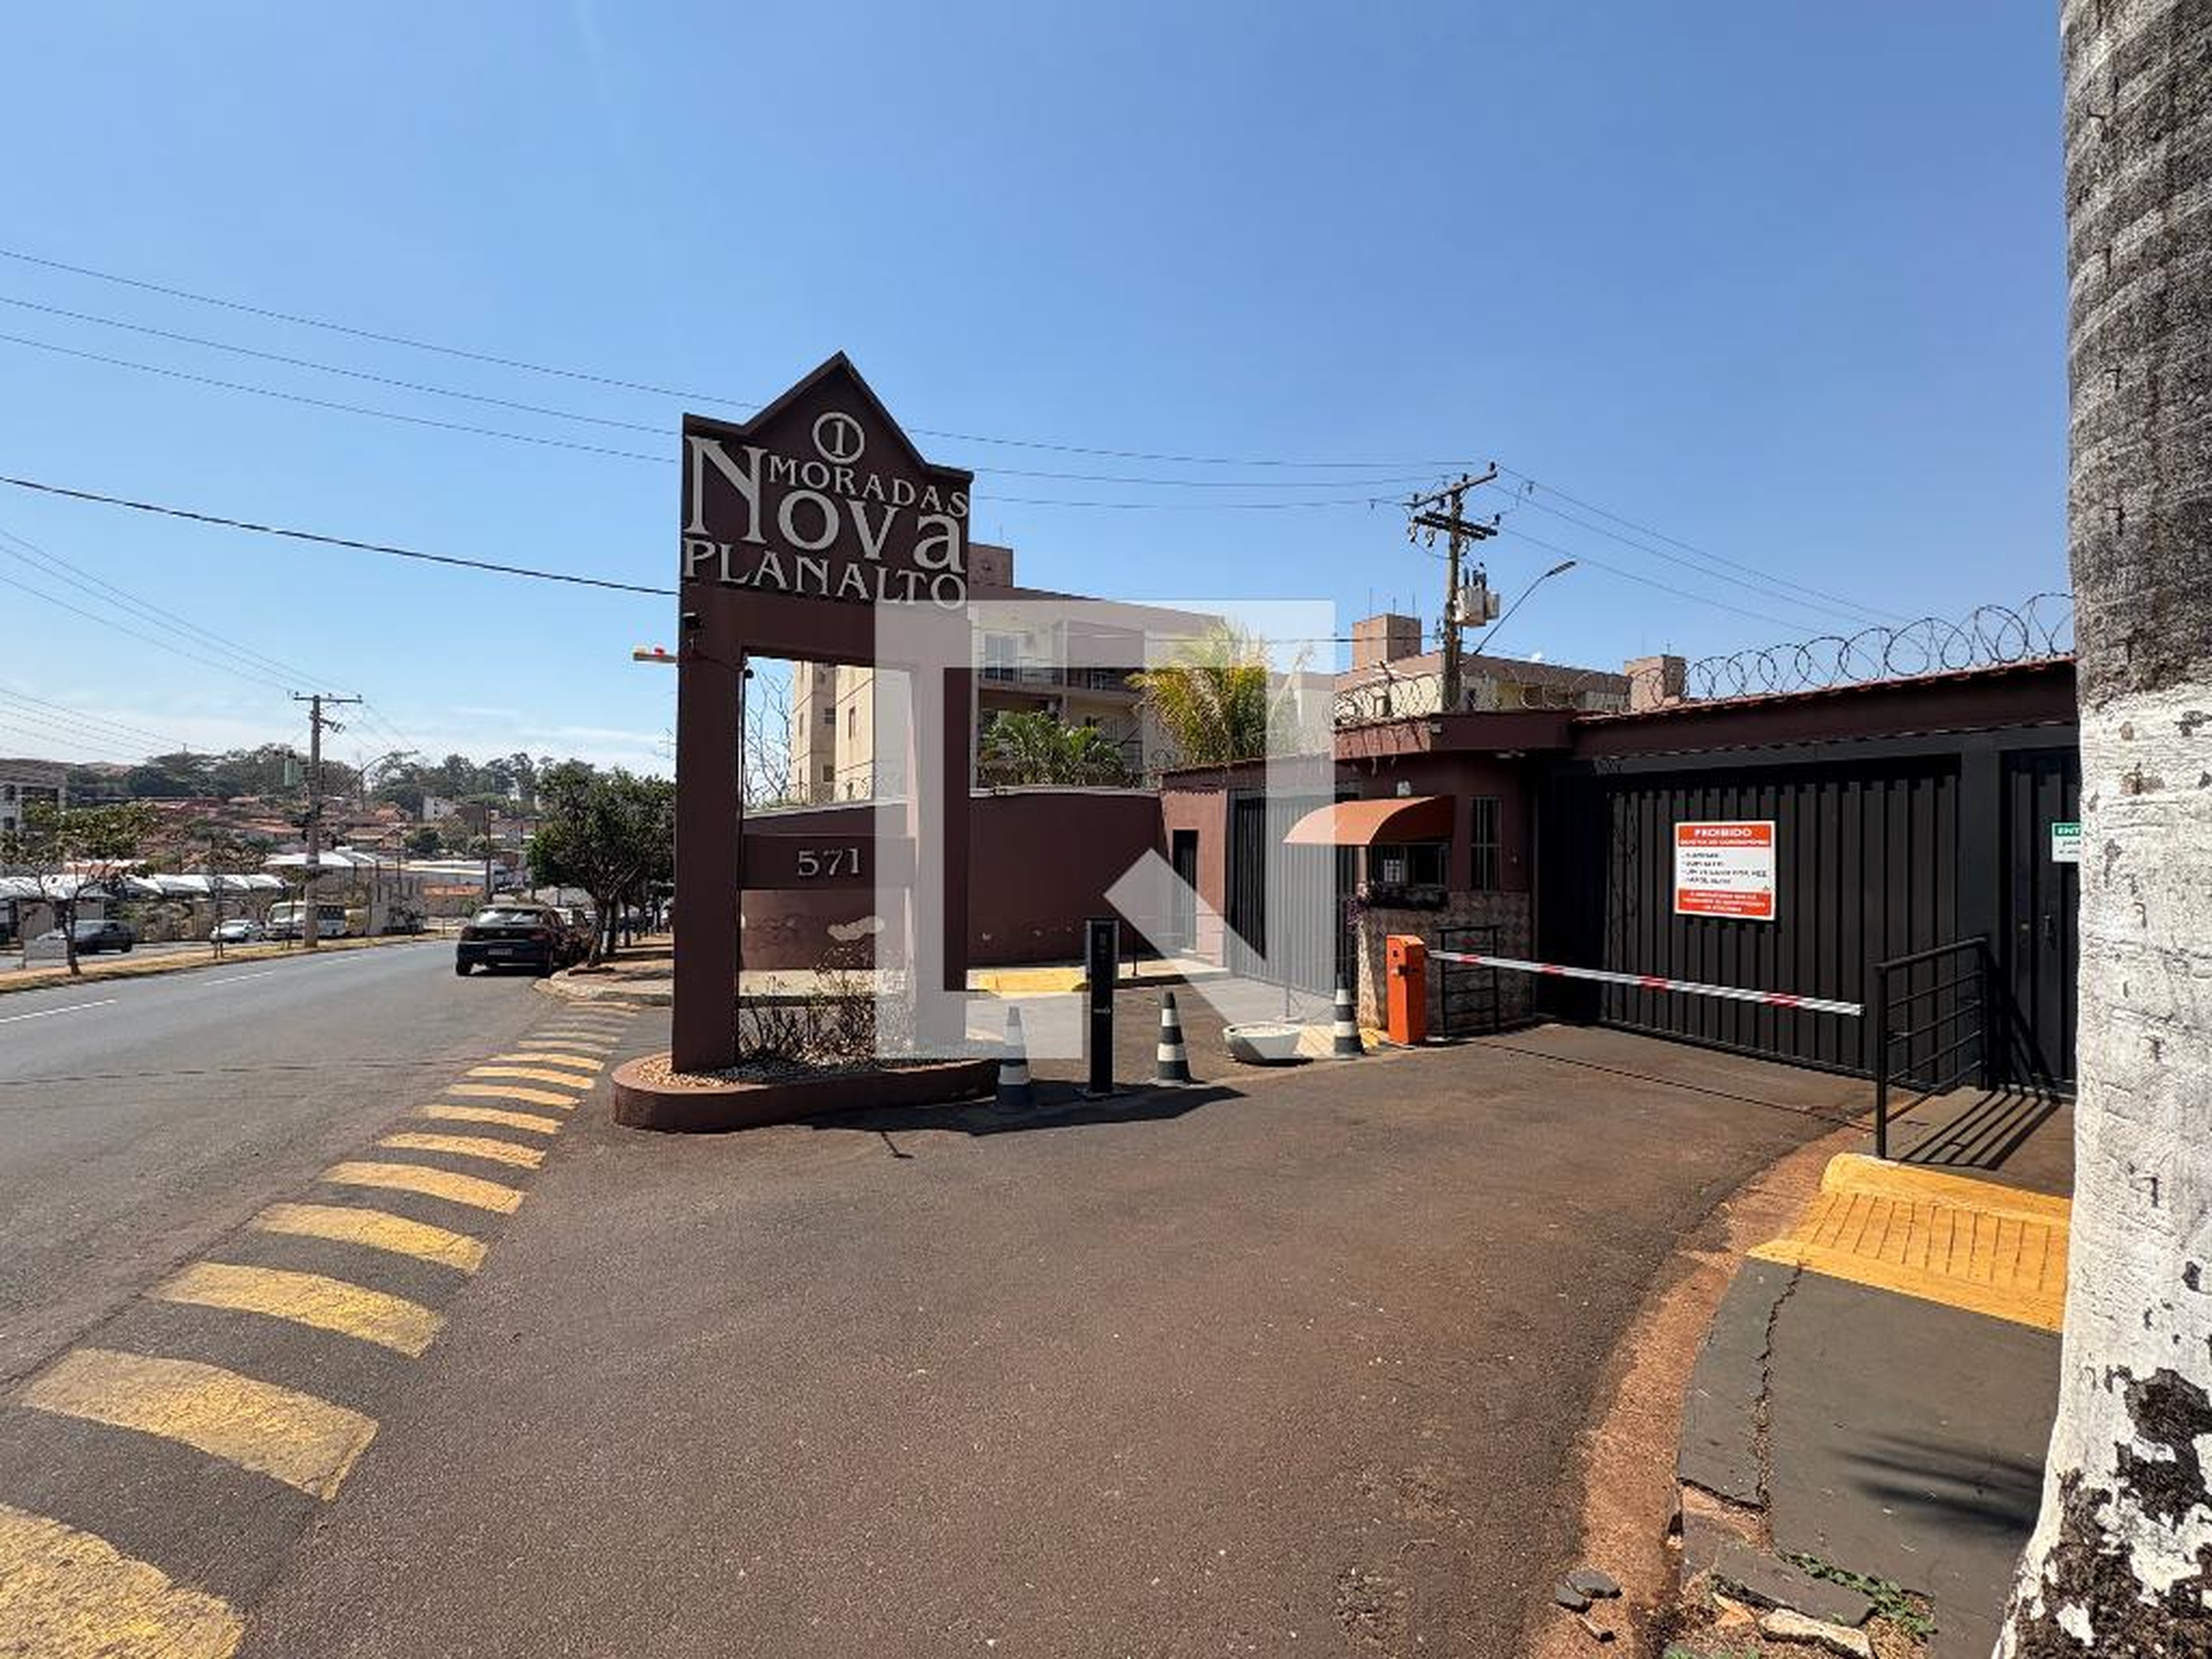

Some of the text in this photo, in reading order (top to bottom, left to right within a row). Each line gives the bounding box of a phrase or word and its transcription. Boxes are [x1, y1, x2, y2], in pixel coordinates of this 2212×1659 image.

[769, 455, 969, 518] MORADAS
[683, 537, 968, 611] PLANALTO
[798, 847, 860, 876] 571
